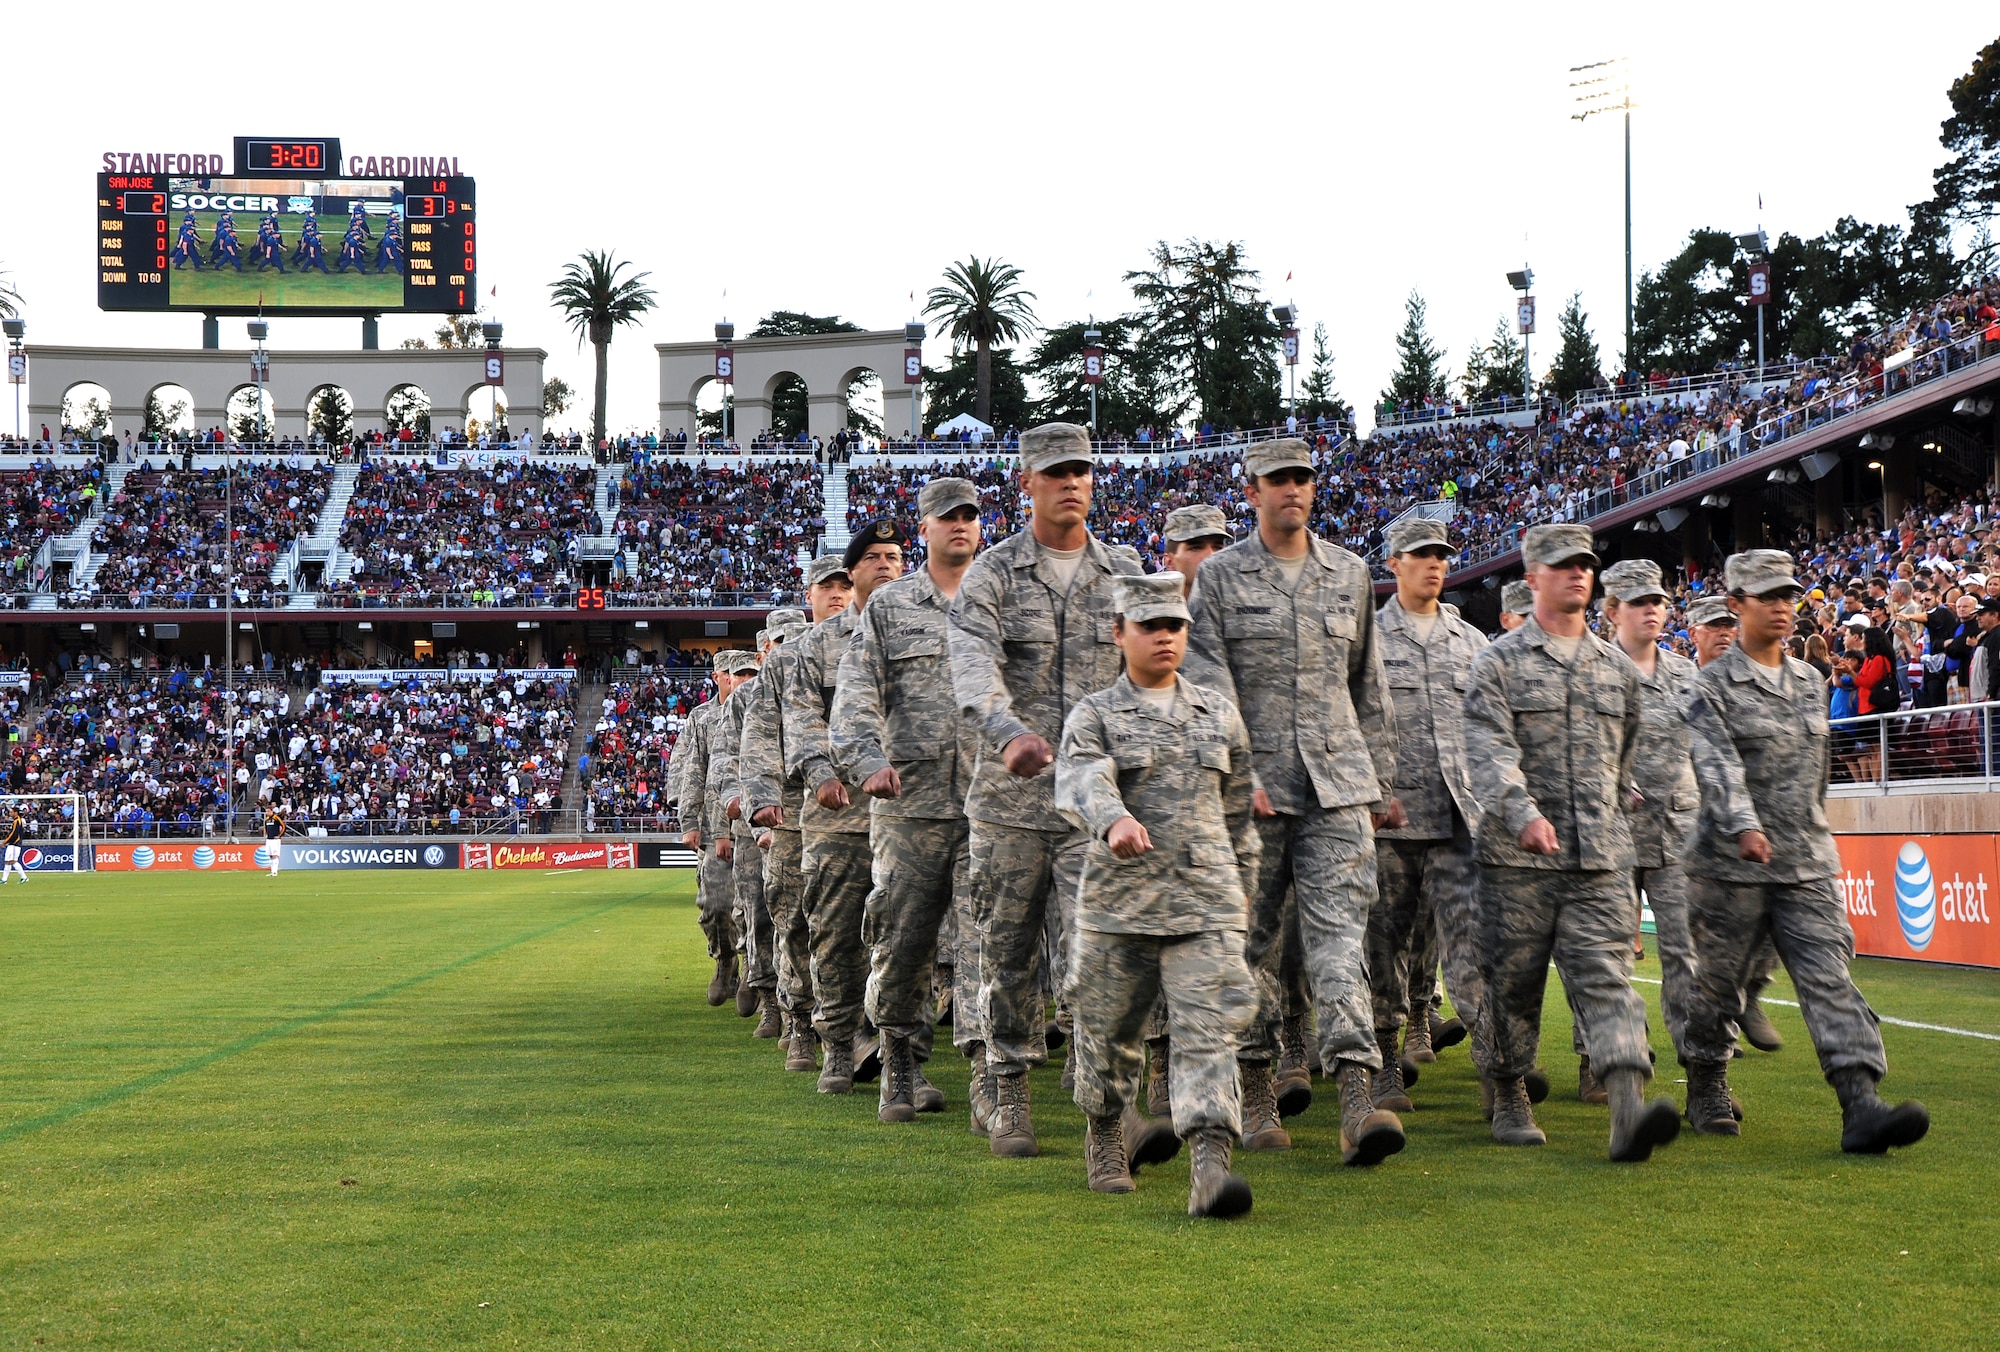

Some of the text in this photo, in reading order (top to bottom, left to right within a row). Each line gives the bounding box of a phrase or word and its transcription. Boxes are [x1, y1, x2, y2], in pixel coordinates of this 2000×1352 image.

[271, 144, 319, 167] 3:20
[102, 152, 223, 174] STANFORD
[350, 155, 463, 177] CARDINAL
[109, 177, 153, 189] SAN JOSE
[433, 181, 446, 192] LA
[116, 196, 124, 210] 3
[152, 194, 164, 213] 2
[171, 194, 279, 211] SOCCER
[424, 197, 434, 216] 3
[447, 200, 455, 213] 3
[101, 220, 123, 231] RUSH
[156, 219, 166, 233] 0
[411, 223, 432, 234] RUSH
[464, 222, 474, 236] 0
[102, 238, 122, 249] PASS
[156, 237, 166, 251] 0
[411, 241, 431, 252] PASS
[464, 240, 474, 254] 0
[101, 256, 124, 267] TOTAL
[156, 255, 166, 269] 0
[410, 259, 433, 270] TOTAL
[464, 258, 474, 272] 0
[102, 272, 127, 283] DOWN
[138, 273, 161, 283] TO GO
[411, 275, 436, 286] BALL ON
[449, 275, 466, 286] QTR
[1751, 273, 1766, 295] S
[459, 289, 464, 306] 1
[1519, 305, 1532, 326] S
[1285, 337, 1296, 357] S
[10, 356, 24, 376] S
[487, 358, 500, 378] S
[717, 356, 731, 376] S
[906, 356, 920, 376] S
[1086, 356, 1100, 376] S
[578, 589, 604, 608] 25
[45, 854, 74, 864] peps
[96, 851, 120, 863] at&t
[158, 851, 182, 862] at&t
[218, 851, 242, 862] at&t
[293, 849, 417, 864] VOLKSWAGEN
[495, 846, 546, 867] Chelada
[552, 849, 604, 865] Budweiser
[1836, 870, 1877, 917] at&t
[1941, 872, 1990, 924] at&t
